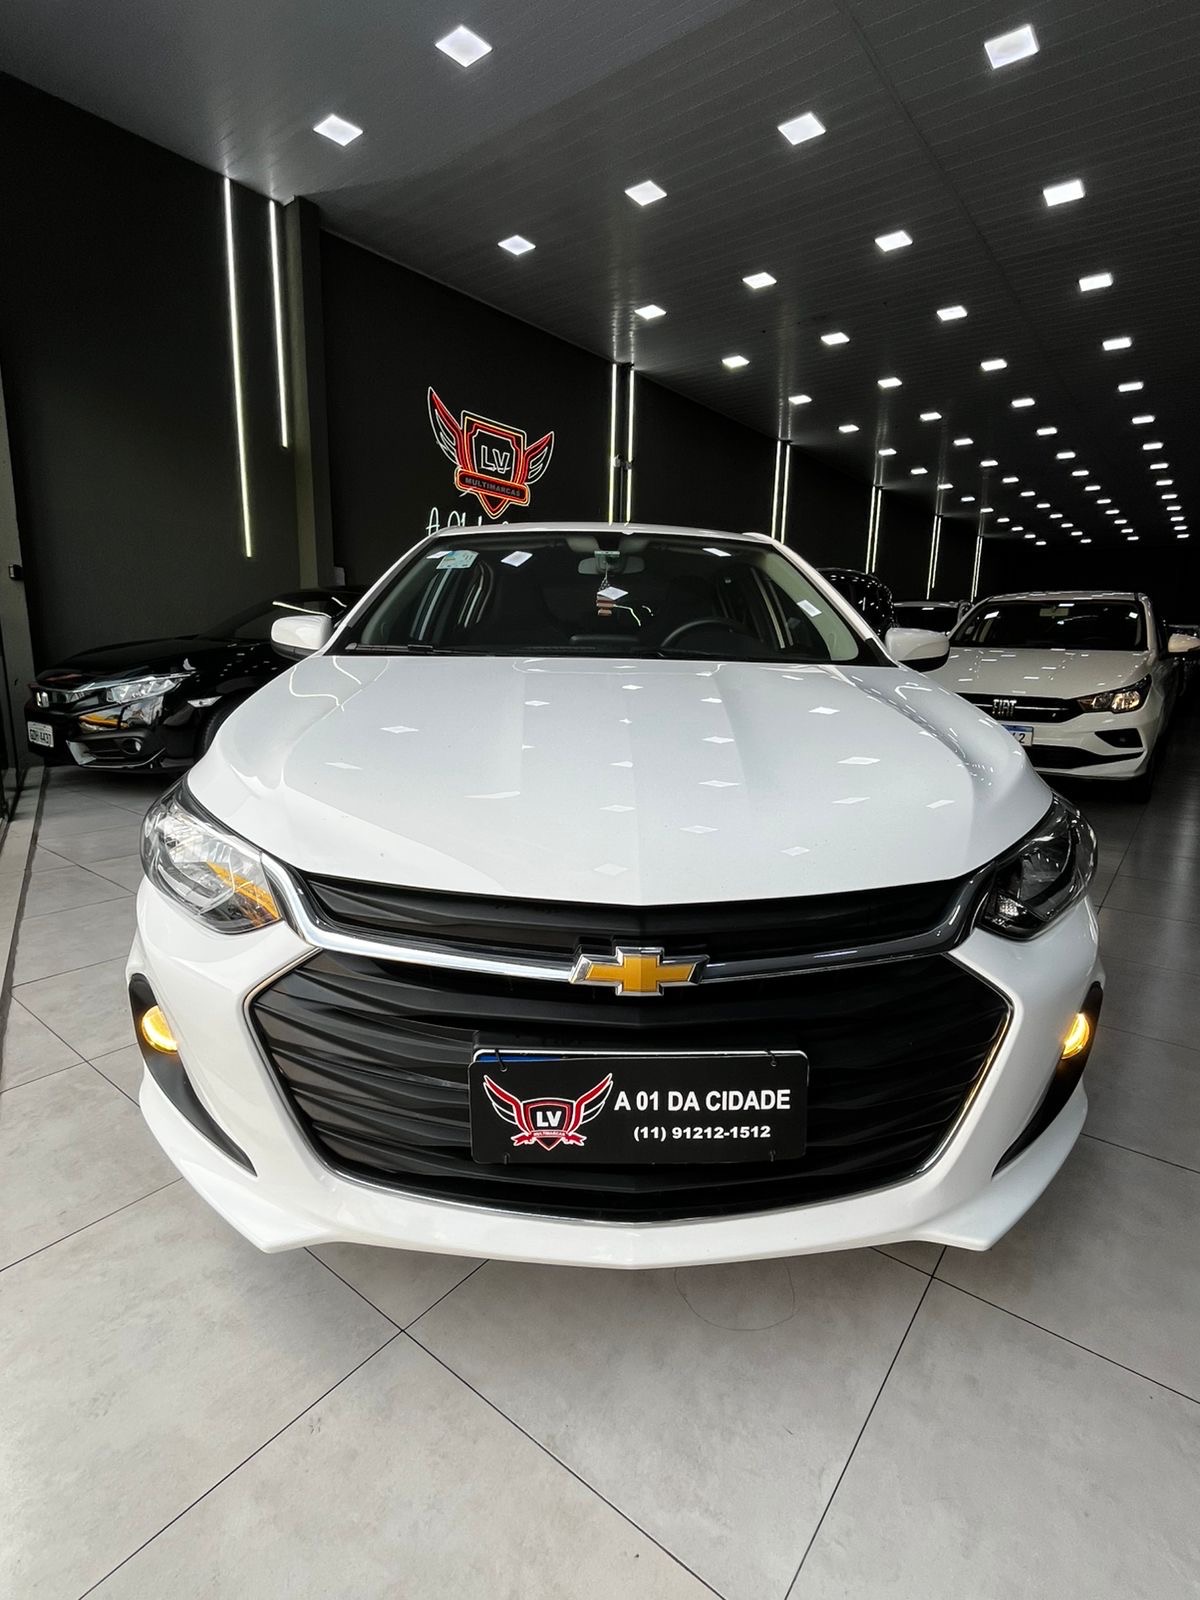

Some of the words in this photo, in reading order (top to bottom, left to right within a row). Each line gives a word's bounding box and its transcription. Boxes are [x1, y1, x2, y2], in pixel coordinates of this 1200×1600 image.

[481, 445, 510, 474] LV
[465, 477, 521, 496] MULTIMARCAS
[992, 699, 1017, 716] FIAT
[614, 1093, 631, 1111] A
[636, 1092, 659, 1111] 01
[667, 1091, 701, 1112] DA
[705, 1089, 791, 1111] CIDADE
[536, 1110, 562, 1128] LV
[633, 1125, 667, 1142] (11)
[671, 1125, 771, 1140] 91212-1512
